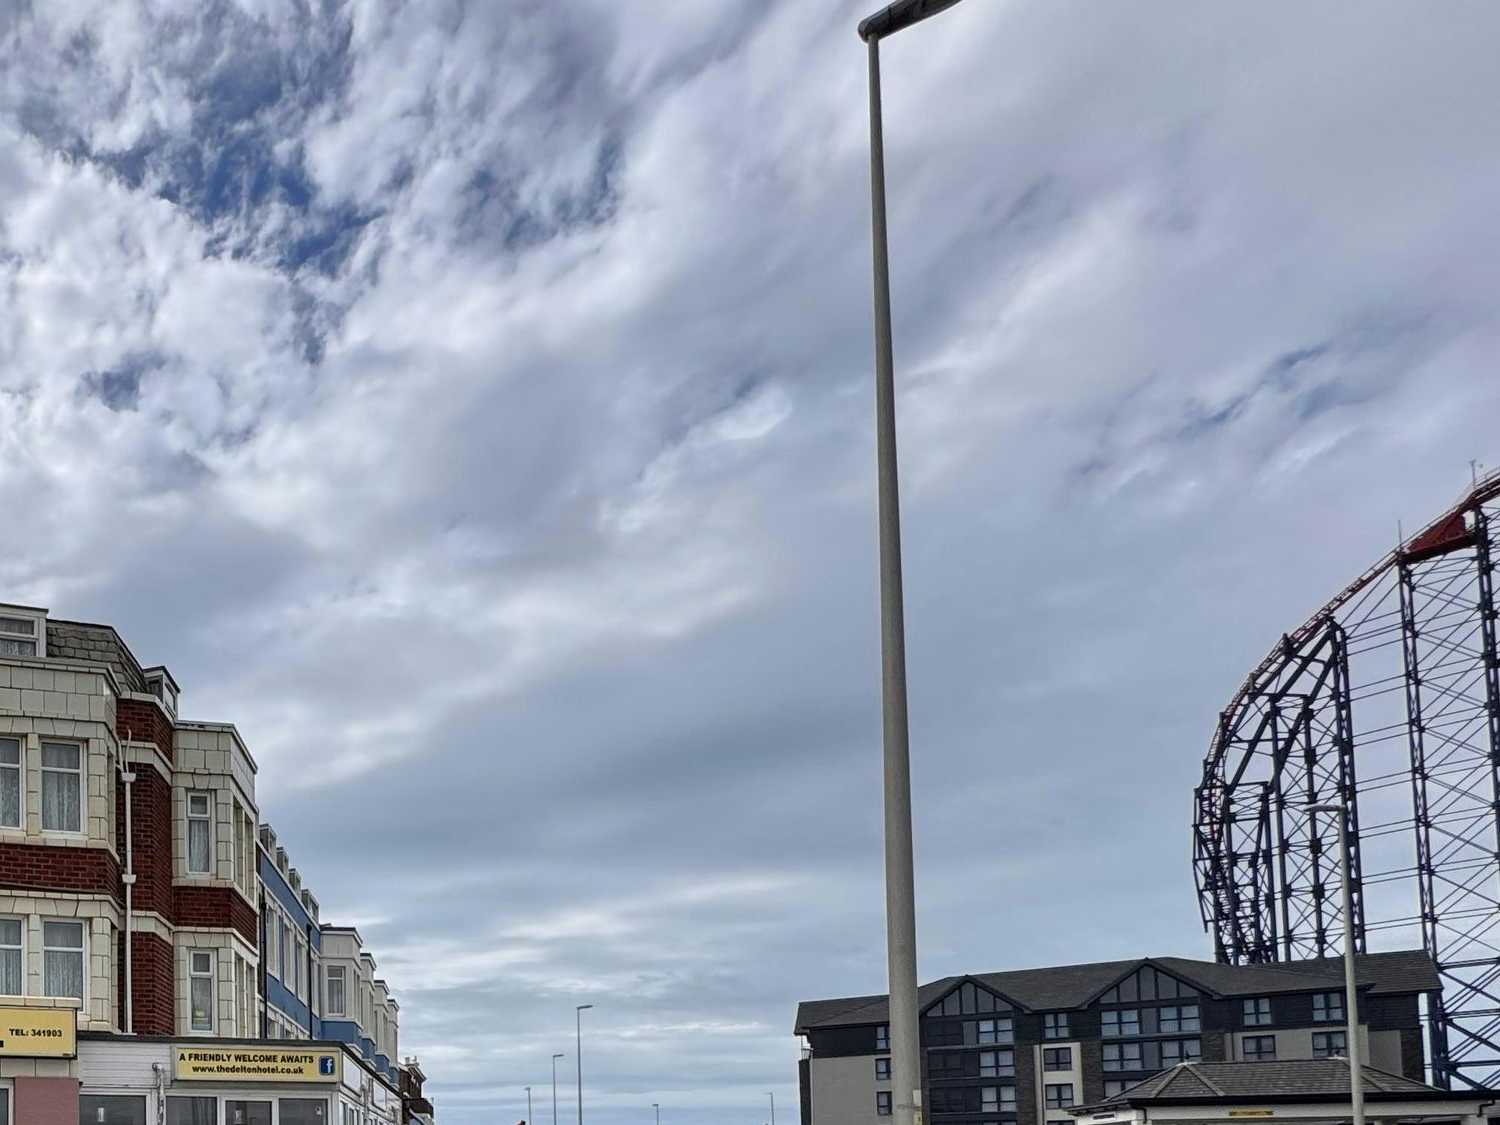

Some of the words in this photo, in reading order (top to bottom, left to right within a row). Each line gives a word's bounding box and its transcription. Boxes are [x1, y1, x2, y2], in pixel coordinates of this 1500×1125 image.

[9, 1028, 29, 1037] TEL:
[31, 1029, 62, 1037] 341903
[179, 1053, 186, 1061] A
[188, 1053, 231, 1062] FRIENDLY
[234, 1054, 278, 1063] WELCOME
[280, 1055, 314, 1063] AWAITS
[192, 1065, 304, 1074] www.thedeltonhotel.co.uk
